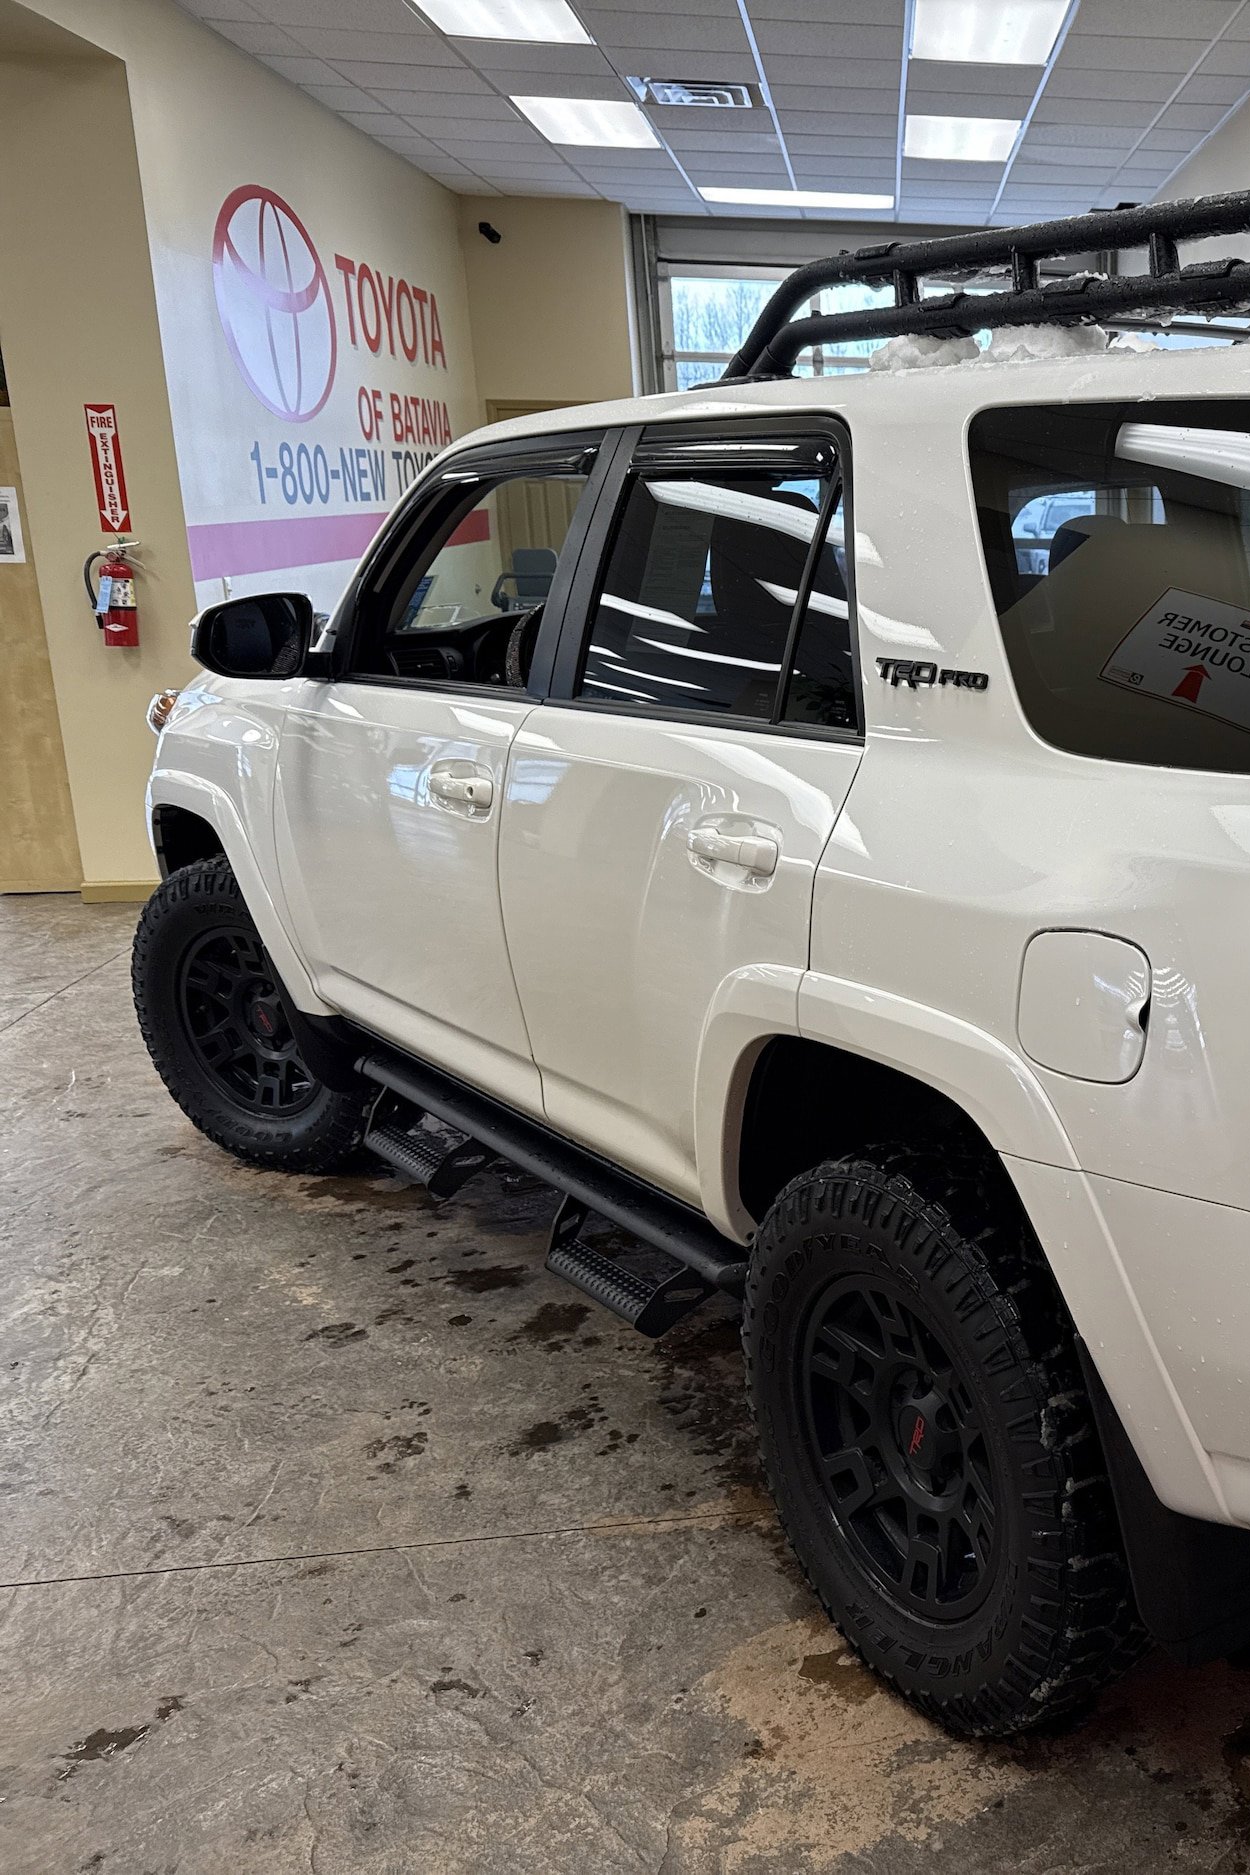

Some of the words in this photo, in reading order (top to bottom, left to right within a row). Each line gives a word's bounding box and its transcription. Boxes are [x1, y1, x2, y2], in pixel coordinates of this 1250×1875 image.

[334, 253, 448, 371] TOYOTA
[89, 416, 113, 428] FIRE
[358, 385, 384, 442] OF
[389, 392, 452, 446] BATAVIA
[99, 433, 120, 523] EXTINGUISHER
[250, 440, 386, 505] 1-800-NEW
[876, 656, 938, 690] TRD
[938, 668, 989, 690] PRO
[759, 1233, 920, 1375] GOODYEAR
[908, 1415, 926, 1455] TRD
